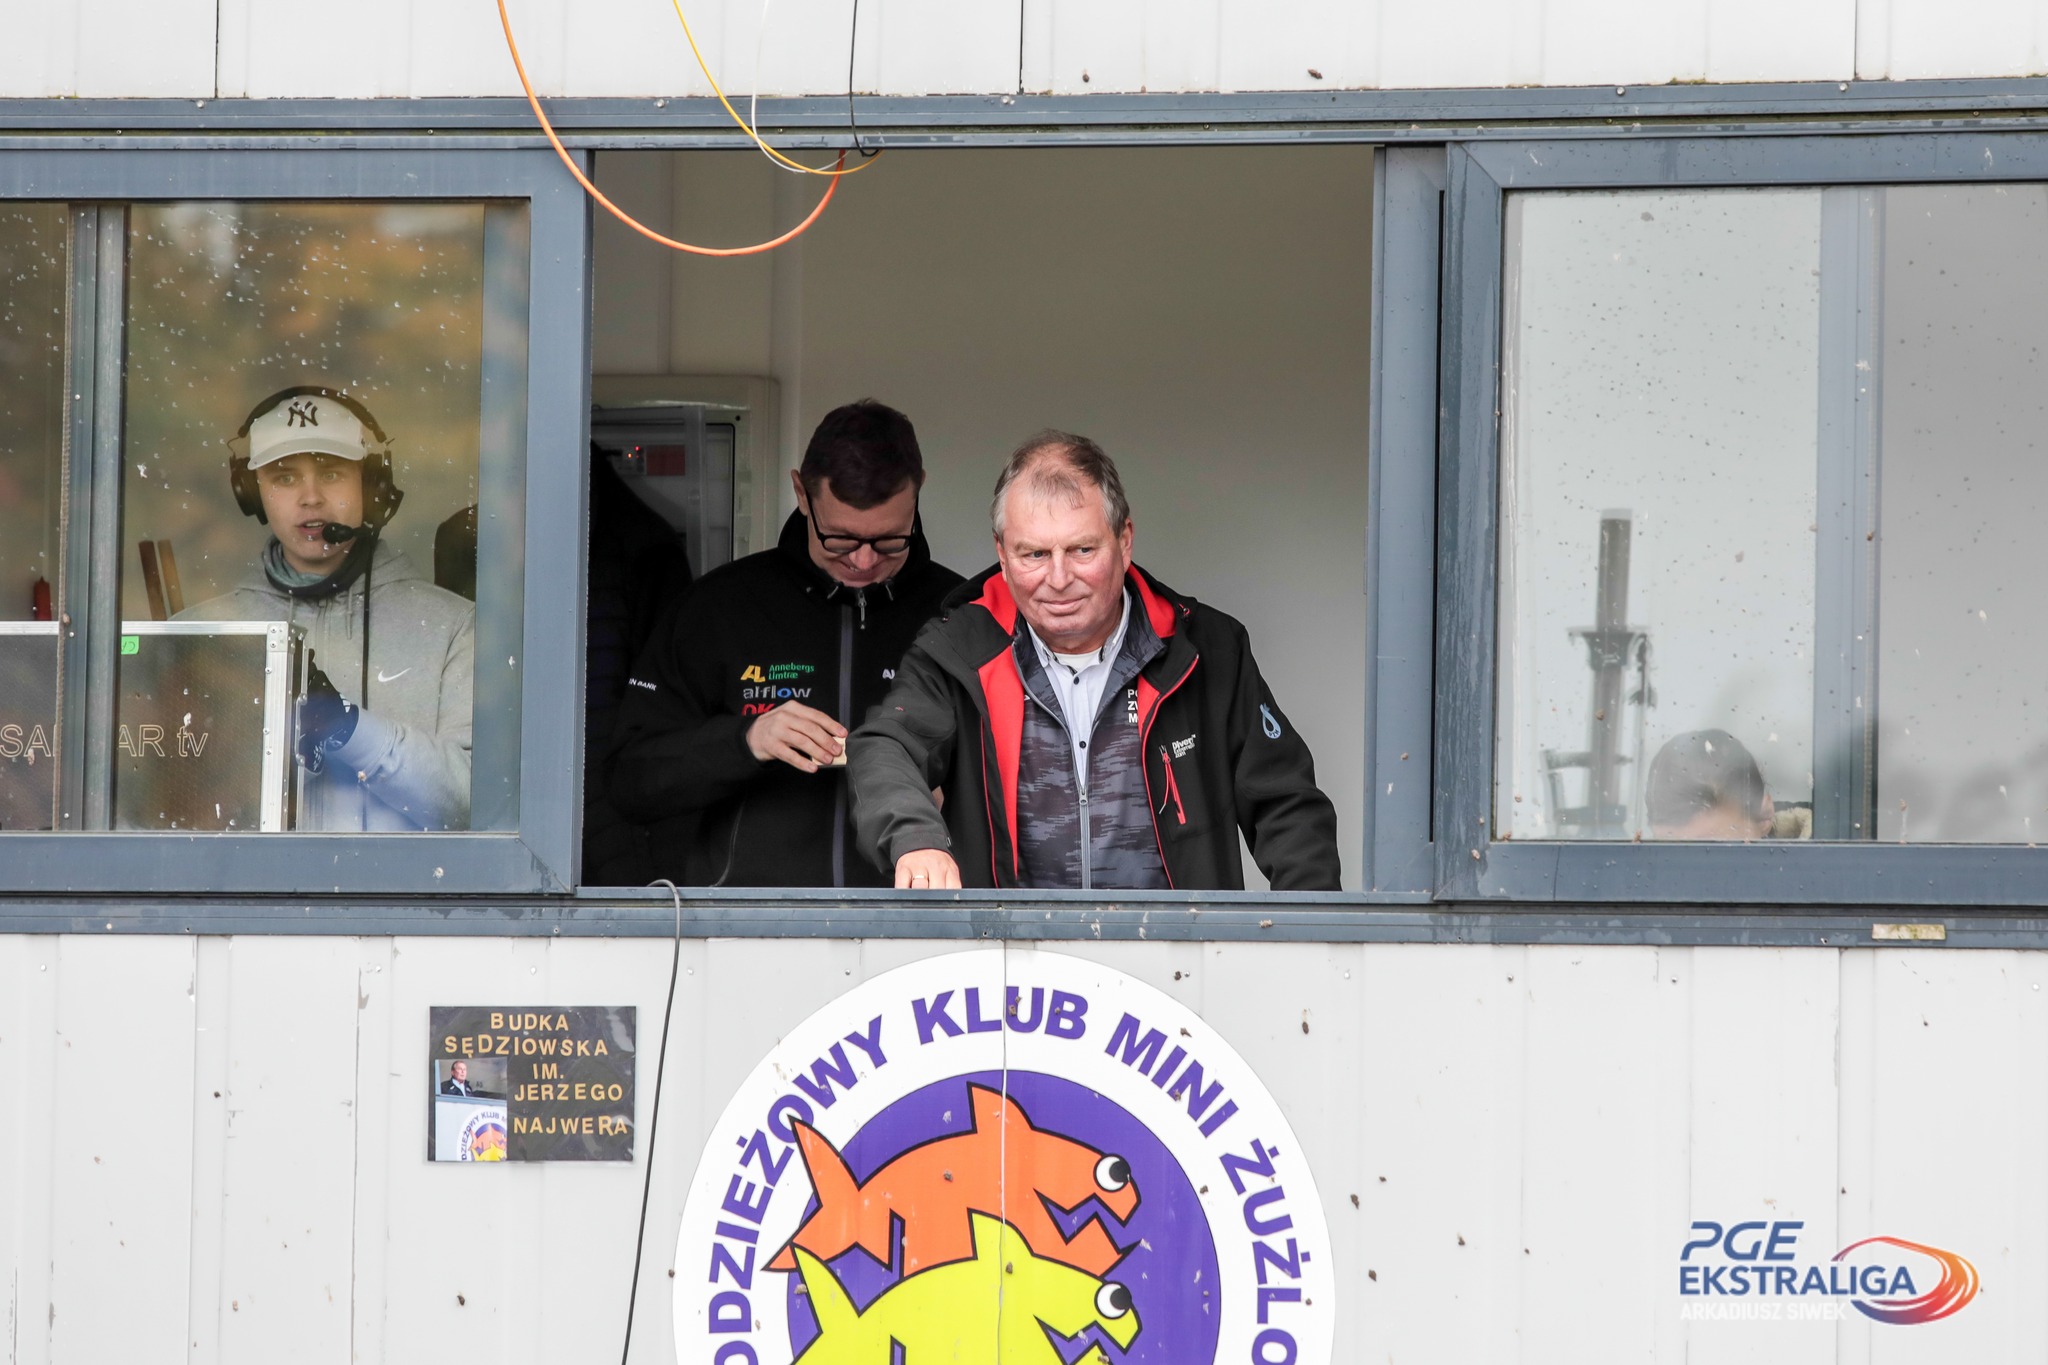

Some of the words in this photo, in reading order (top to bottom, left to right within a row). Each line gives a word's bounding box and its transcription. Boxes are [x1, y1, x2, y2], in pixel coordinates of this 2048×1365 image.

[287, 401, 319, 427] NY
[769, 662, 815, 673] Annebergs
[177, 725, 209, 757] tv
[490, 1012, 569, 1032] BUDKA
[444, 1034, 609, 1058] SĘDZIOWSKA
[532, 1063, 565, 1080] IM.
[912, 986, 1089, 1045] KLUB
[1104, 1012, 1239, 1138] MINI
[514, 1083, 623, 1102] JERZEGO
[513, 1116, 628, 1136] NAJWERA
